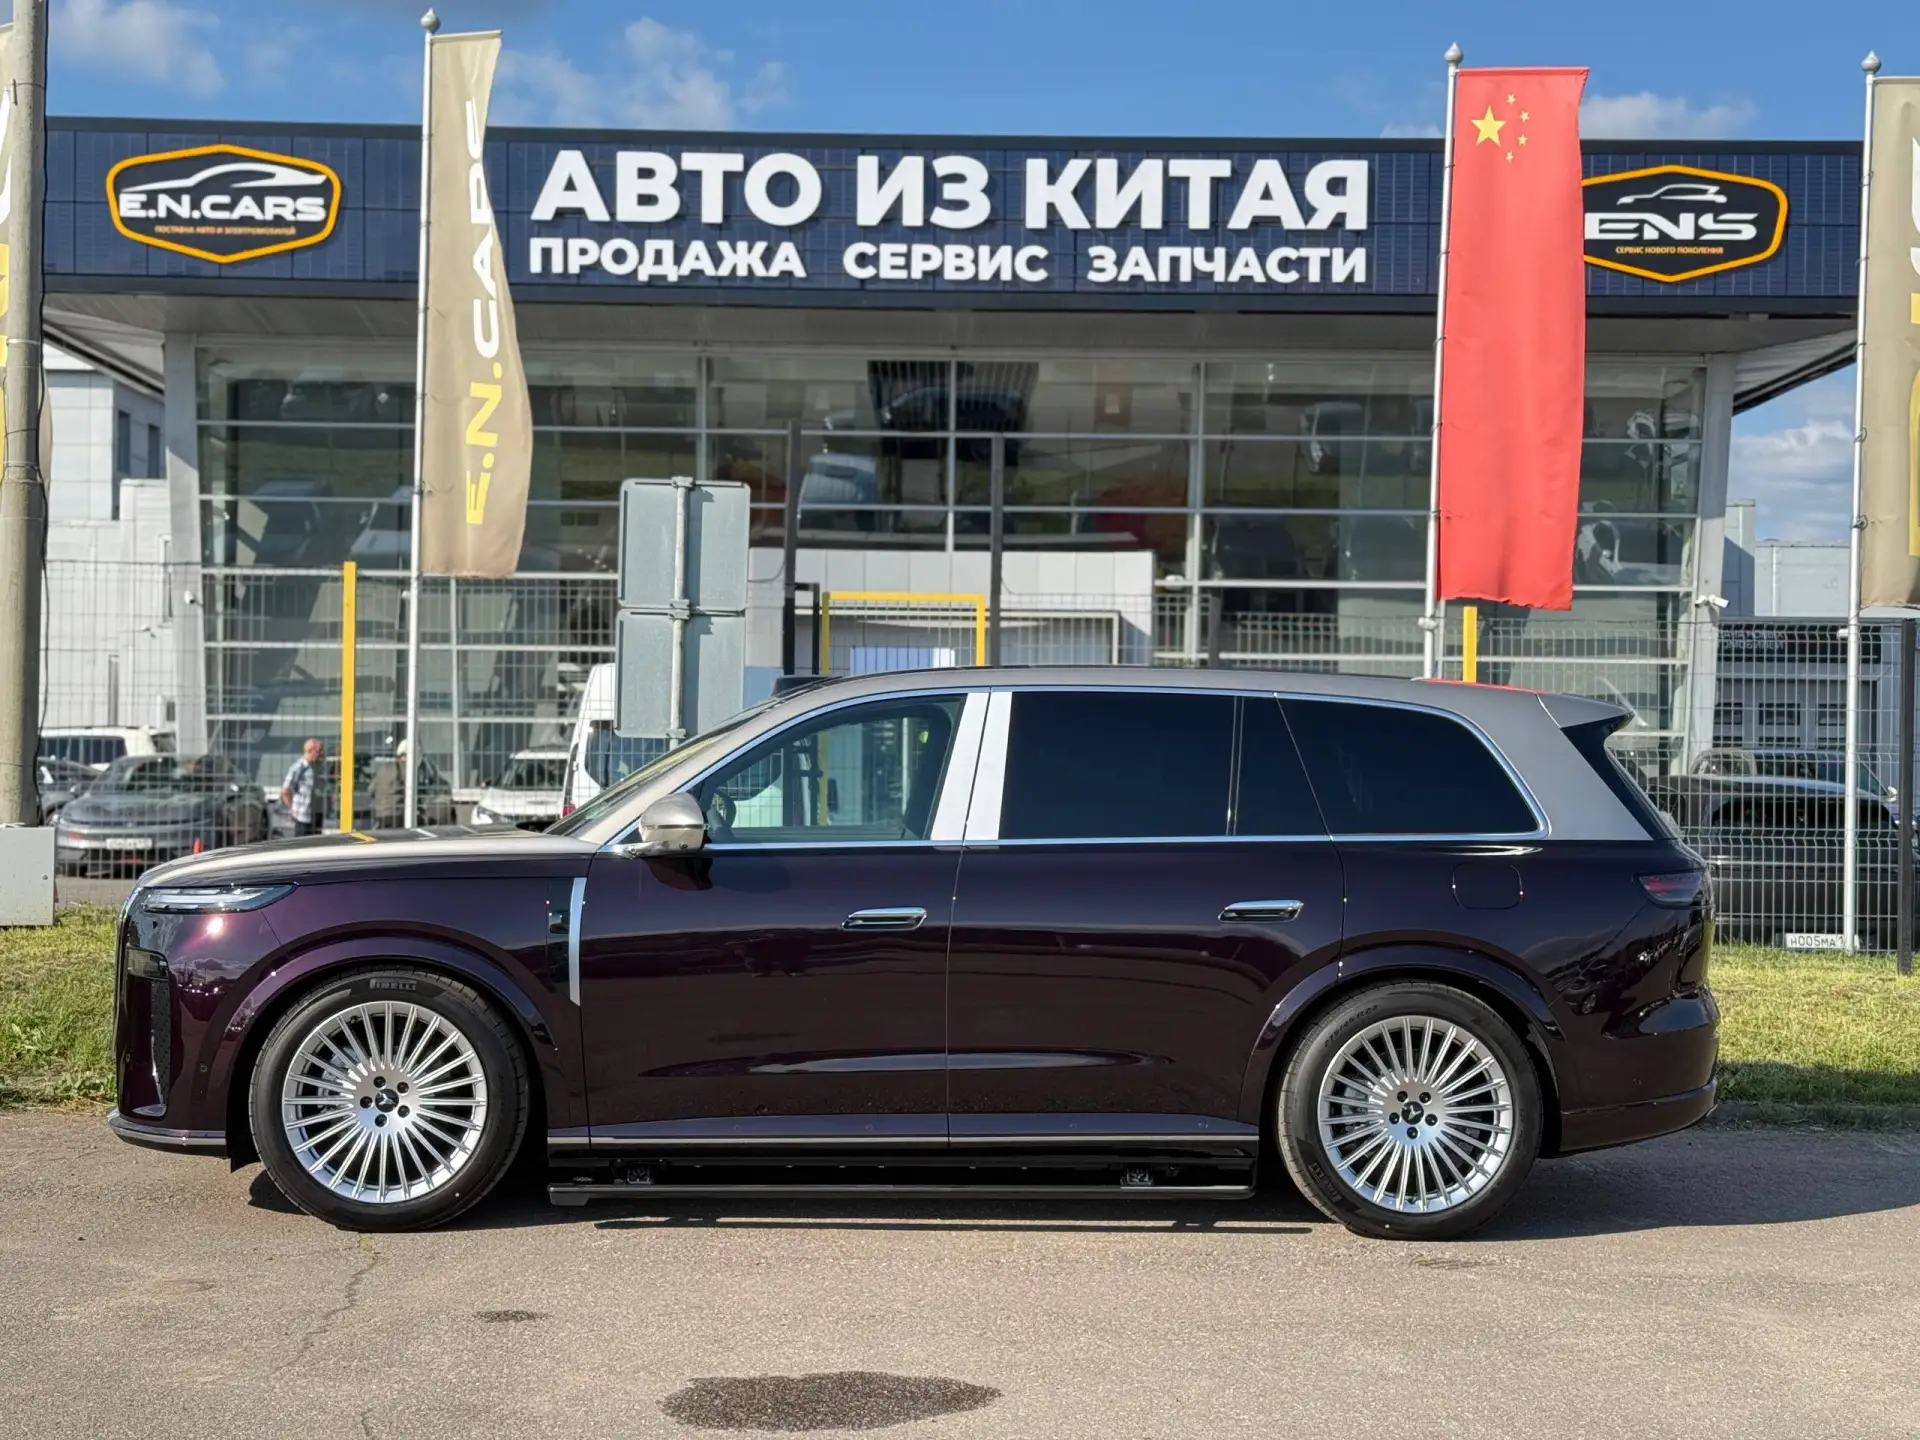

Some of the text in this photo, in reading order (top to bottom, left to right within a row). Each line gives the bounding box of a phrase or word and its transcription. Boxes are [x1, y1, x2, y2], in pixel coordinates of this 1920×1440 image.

[530, 149, 1369, 231] АВТО ИЗ КИТАЯ
[119, 192, 327, 222] E.N.CARS
[1584, 212, 1759, 241] ENS
[529, 237, 1368, 284] ПРОДАЖА СЕРВИС ЗАПЧАСТИ
[1615, 246, 1644, 255] СЕРВИС
[1645, 246, 1676, 255] НОВОГО
